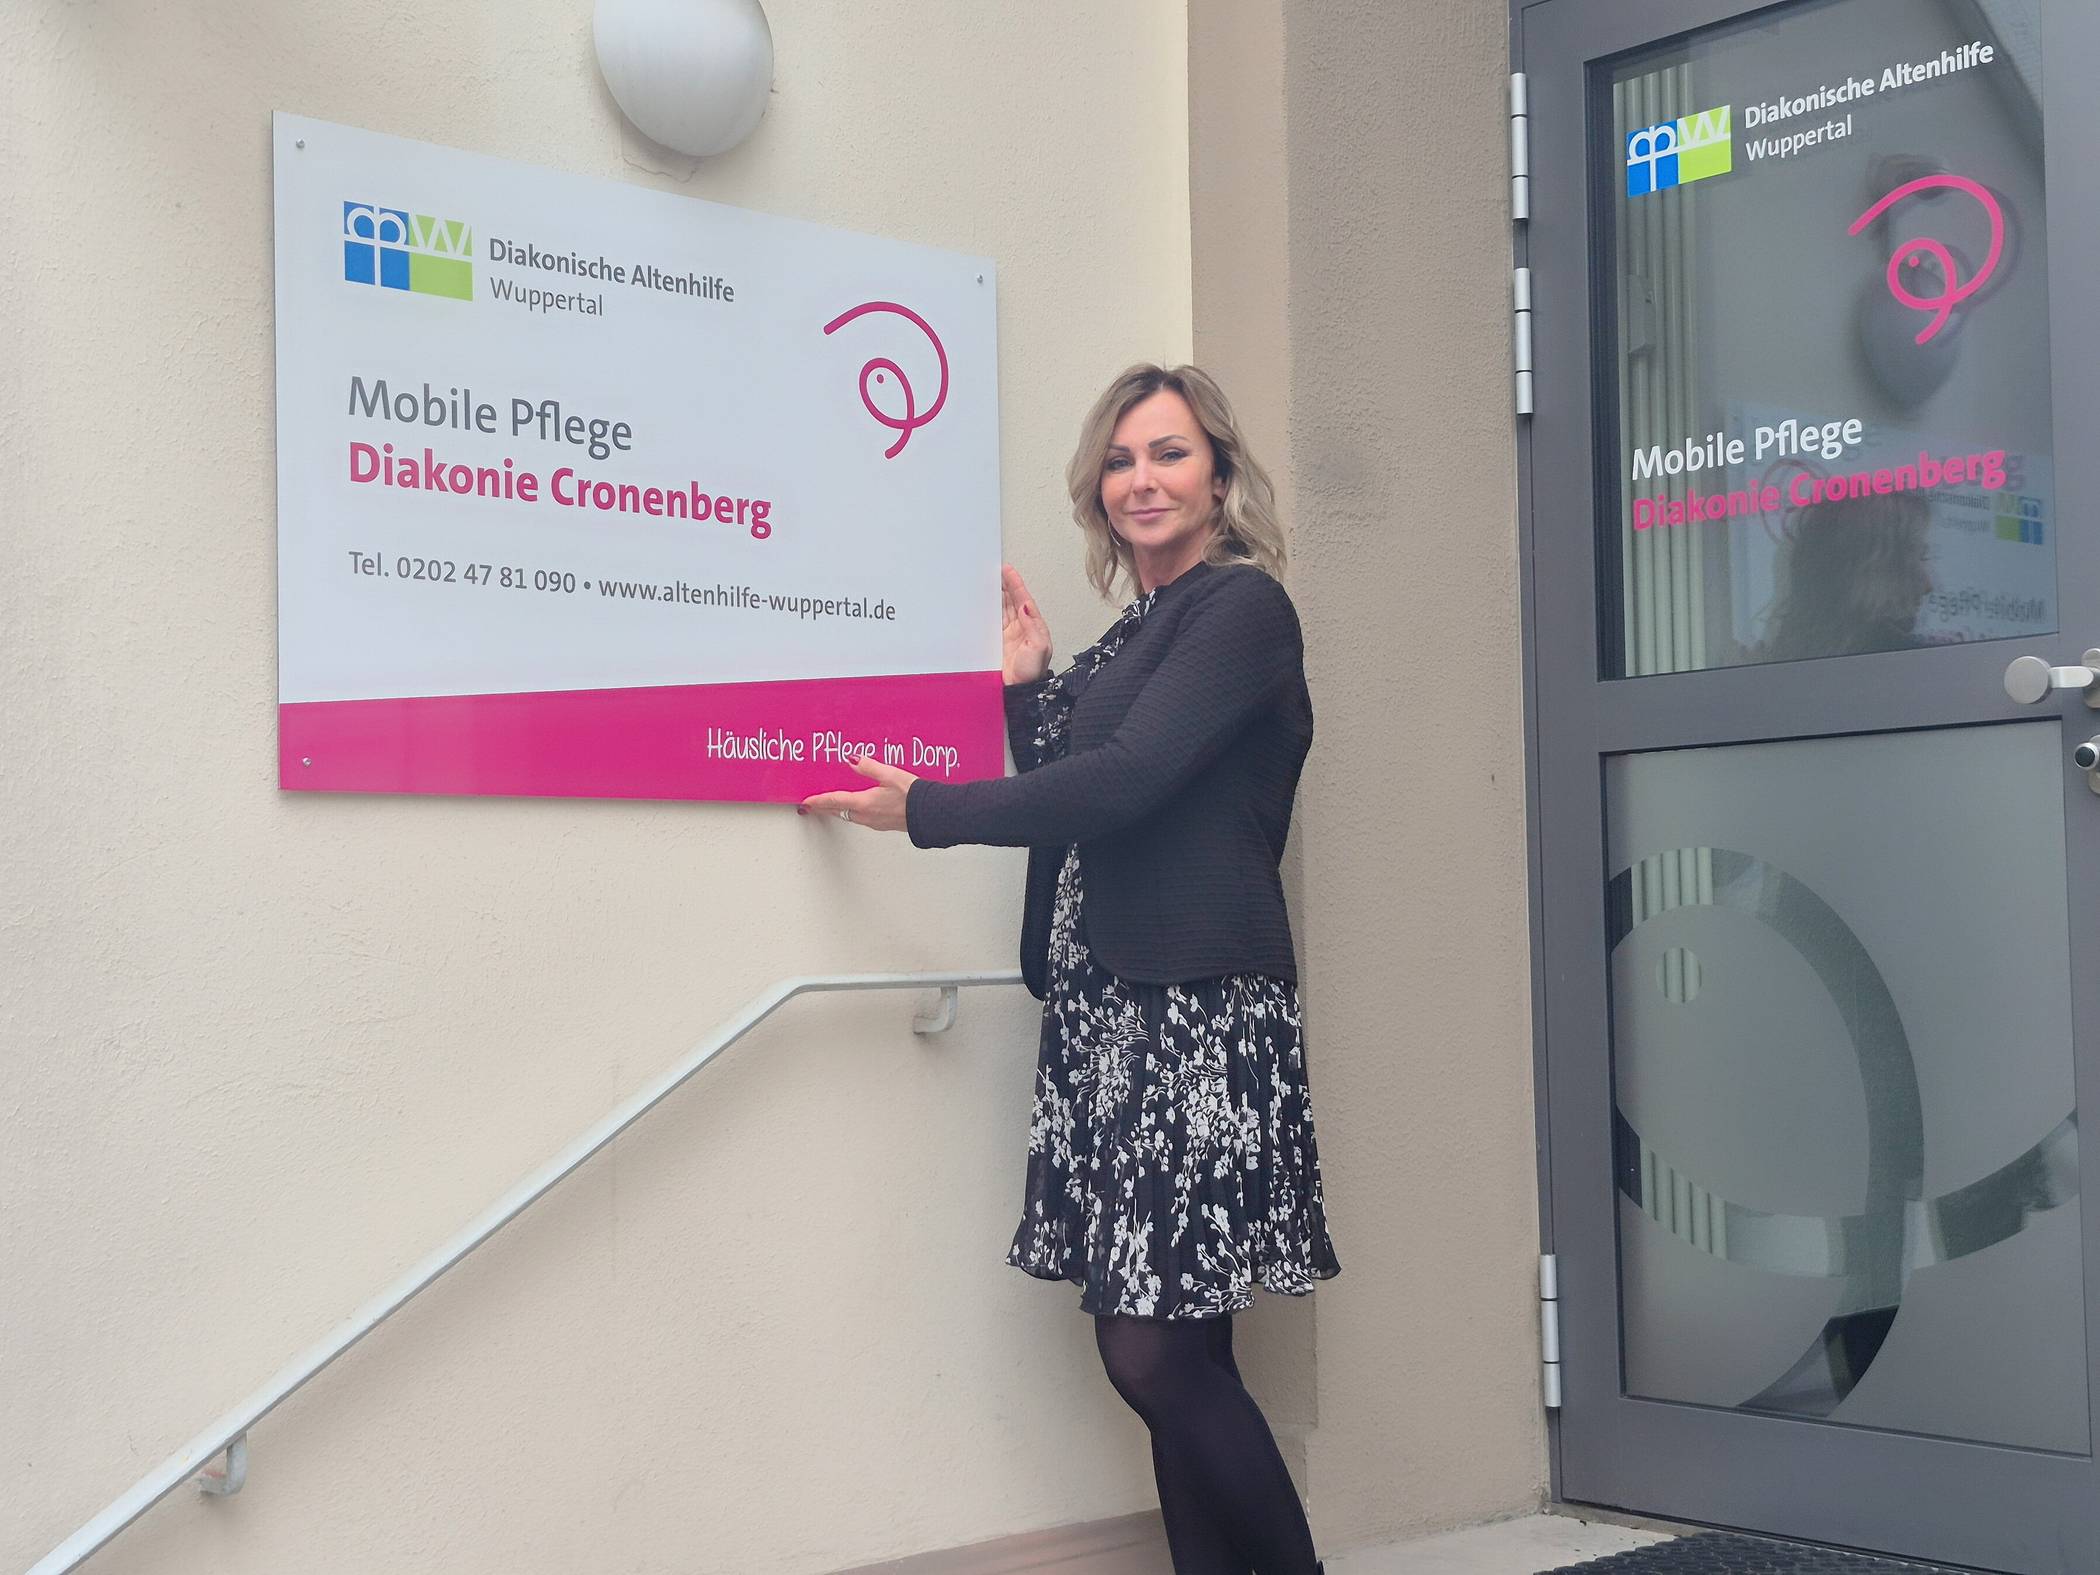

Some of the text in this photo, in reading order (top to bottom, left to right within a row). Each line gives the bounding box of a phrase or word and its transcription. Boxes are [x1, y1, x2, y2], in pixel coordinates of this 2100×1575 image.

[1744, 40, 1995, 130] Diakonische Altenhilfe
[1745, 114, 1853, 162] Wuppertal
[489, 237, 735, 303] Diakonische Altenhilfe
[490, 277, 604, 316] Wuppertal
[348, 375, 633, 460] Mobile Pflege
[1631, 417, 1863, 481] Mobile Pflege
[349, 441, 772, 540] Diakonie Cronenberg
[1632, 479, 1781, 532] Diakonie
[1787, 449, 2008, 506] Cronenberg
[348, 550, 896, 623] Tel. 0202 47 81 090 www.altenhilfe-wuppertal.de
[707, 727, 805, 762] Häusliche
[884, 737, 905, 766] im
[912, 736, 961, 778] Dorp.
